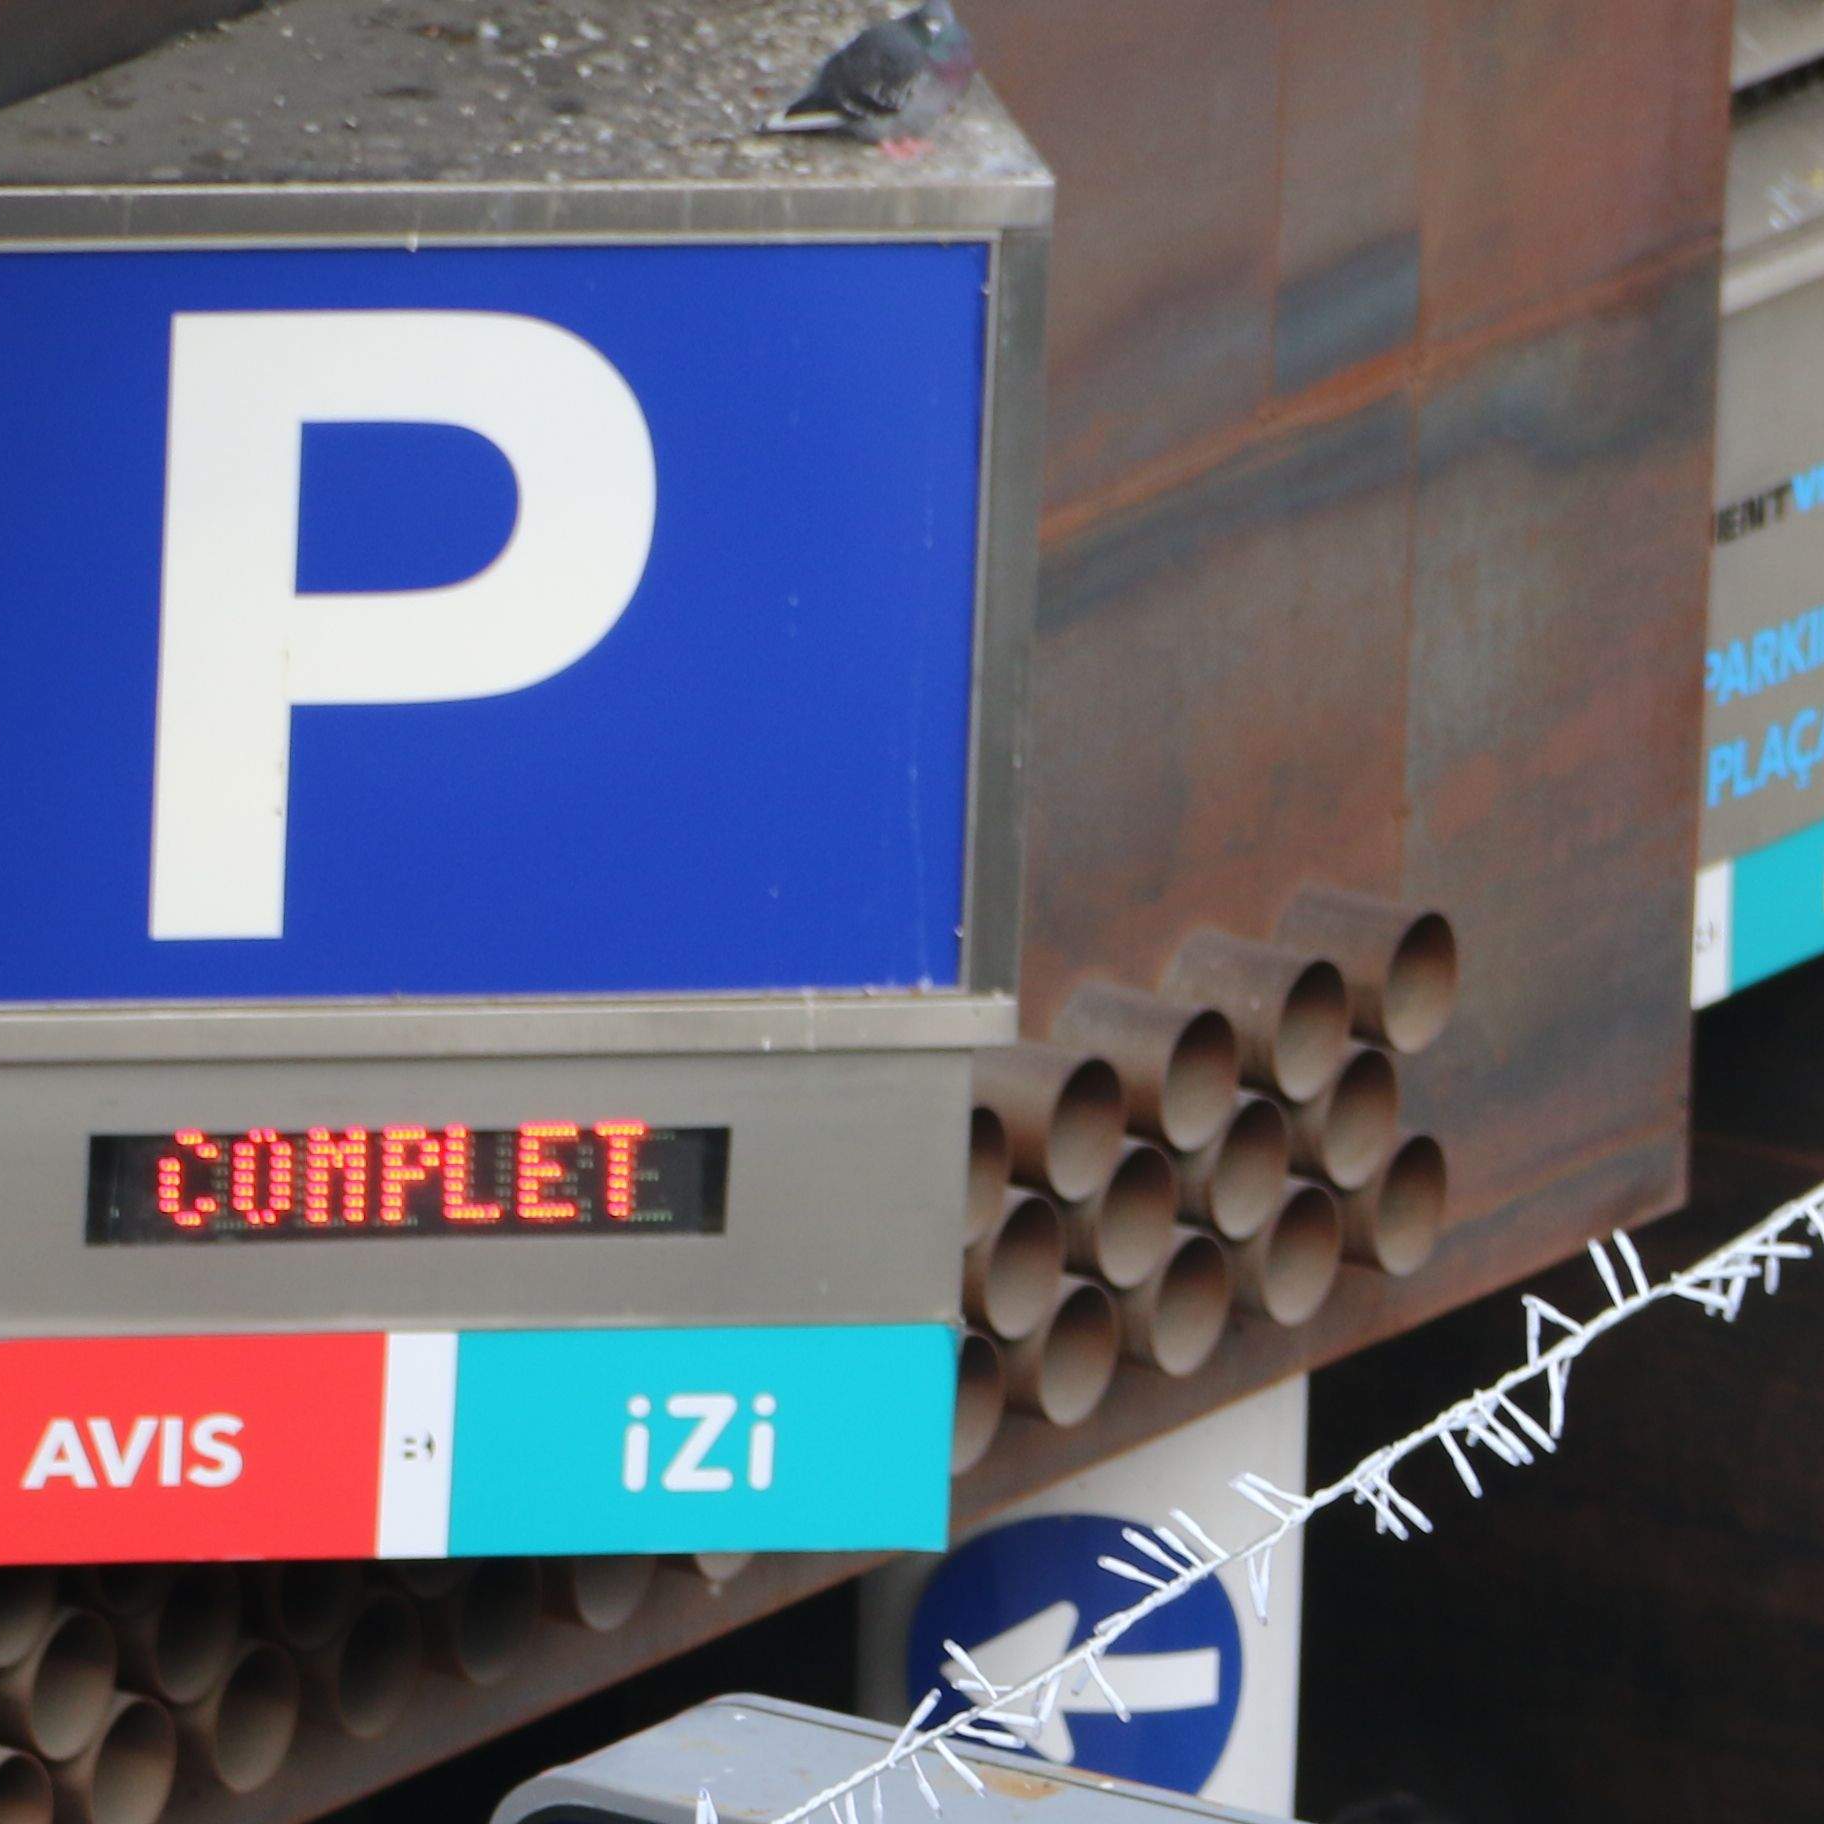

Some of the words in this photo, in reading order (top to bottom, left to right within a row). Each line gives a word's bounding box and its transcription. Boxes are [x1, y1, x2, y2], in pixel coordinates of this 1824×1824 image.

[148, 309, 657, 941] P
[157, 1119, 648, 1227] COMPLET
[22, 1414, 244, 1489] AVIS
[624, 1395, 775, 1490] iZi
